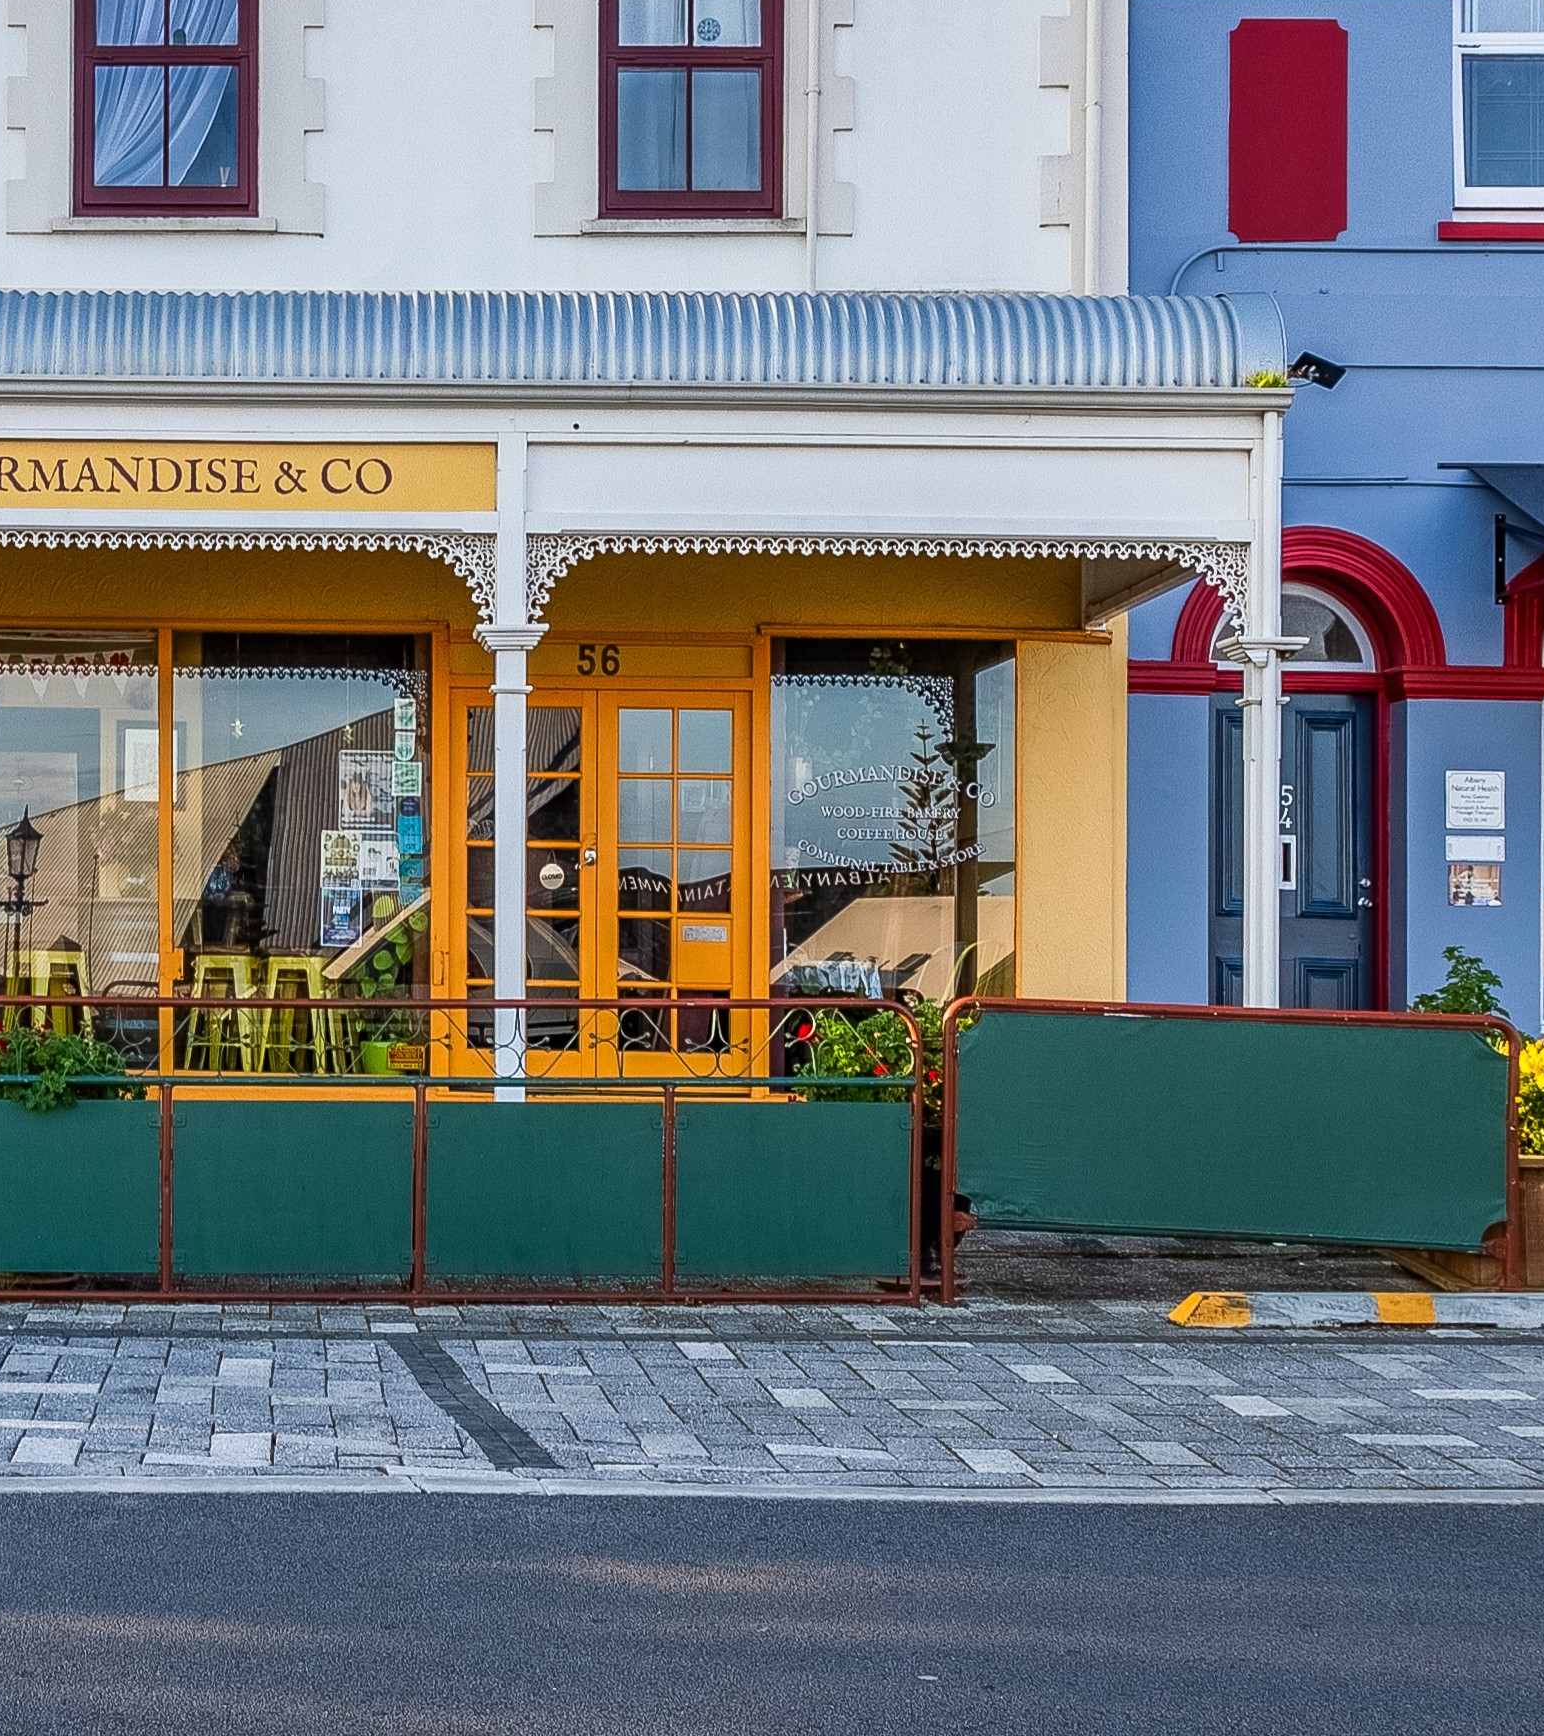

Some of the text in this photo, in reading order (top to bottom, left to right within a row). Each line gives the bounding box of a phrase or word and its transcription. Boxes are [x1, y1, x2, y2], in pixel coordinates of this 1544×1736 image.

[272, 460, 309, 495] &
[320, 457, 395, 496] CO
[577, 644, 620, 676] 56
[787, 765, 996, 808] GOURMANDISE & CO
[821, 806, 962, 821] WOOD-FIRE BAKERY
[837, 828, 946, 841] COFFEE HOUSE
[797, 839, 988, 874] COMMUNAL TABLE & STORE
